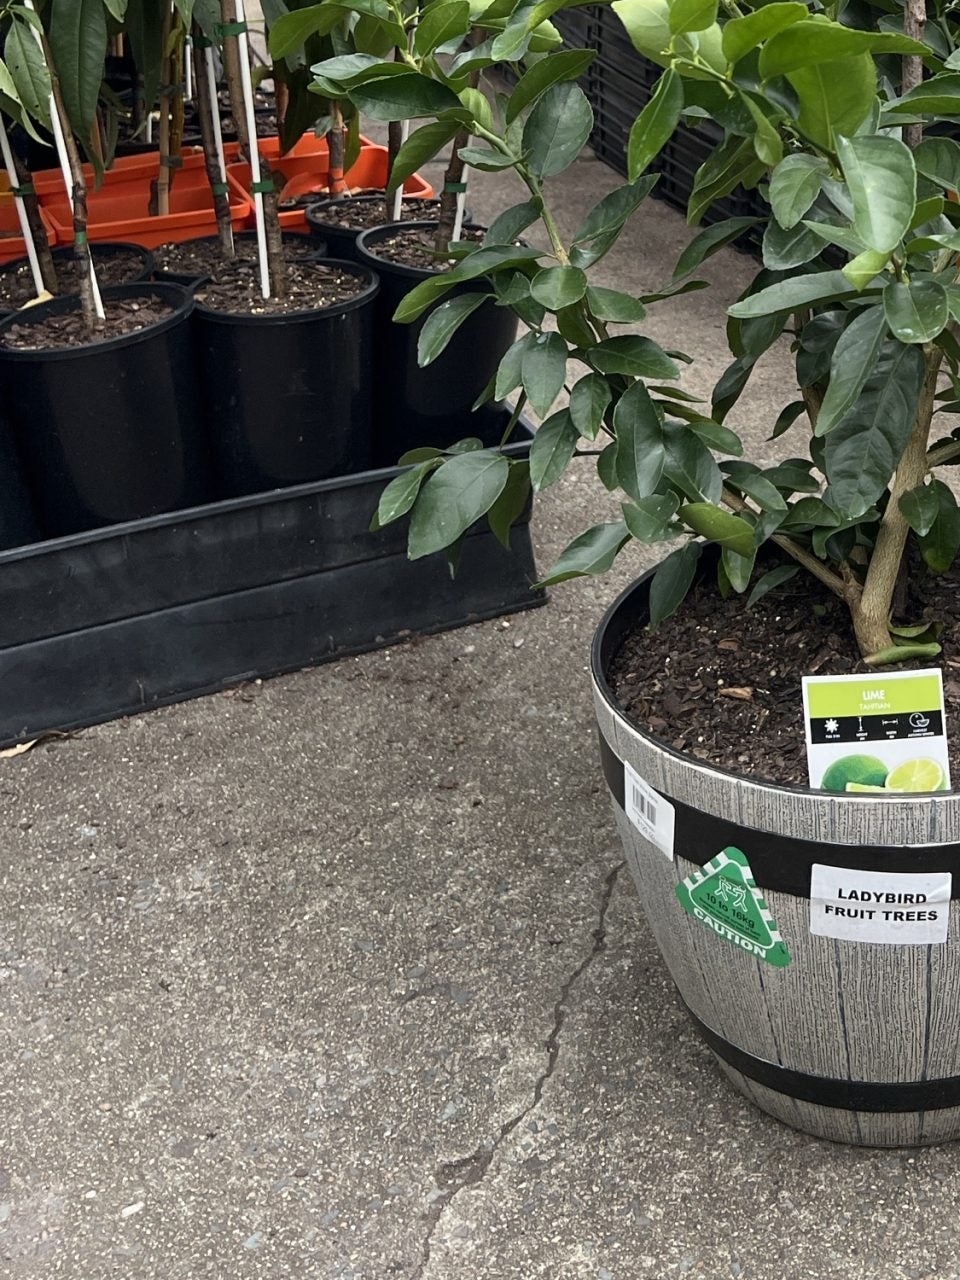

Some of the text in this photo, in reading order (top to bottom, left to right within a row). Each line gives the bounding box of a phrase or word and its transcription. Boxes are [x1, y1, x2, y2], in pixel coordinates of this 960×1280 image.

[862, 689, 886, 701] LIME
[858, 702, 891, 711] TAHITIAN
[837, 887, 927, 904] LADYBIRD
[706, 892, 755, 929] 10 to 16kg
[825, 904, 938, 922] FRUIT TREES
[693, 907, 767, 959] CAUTION
